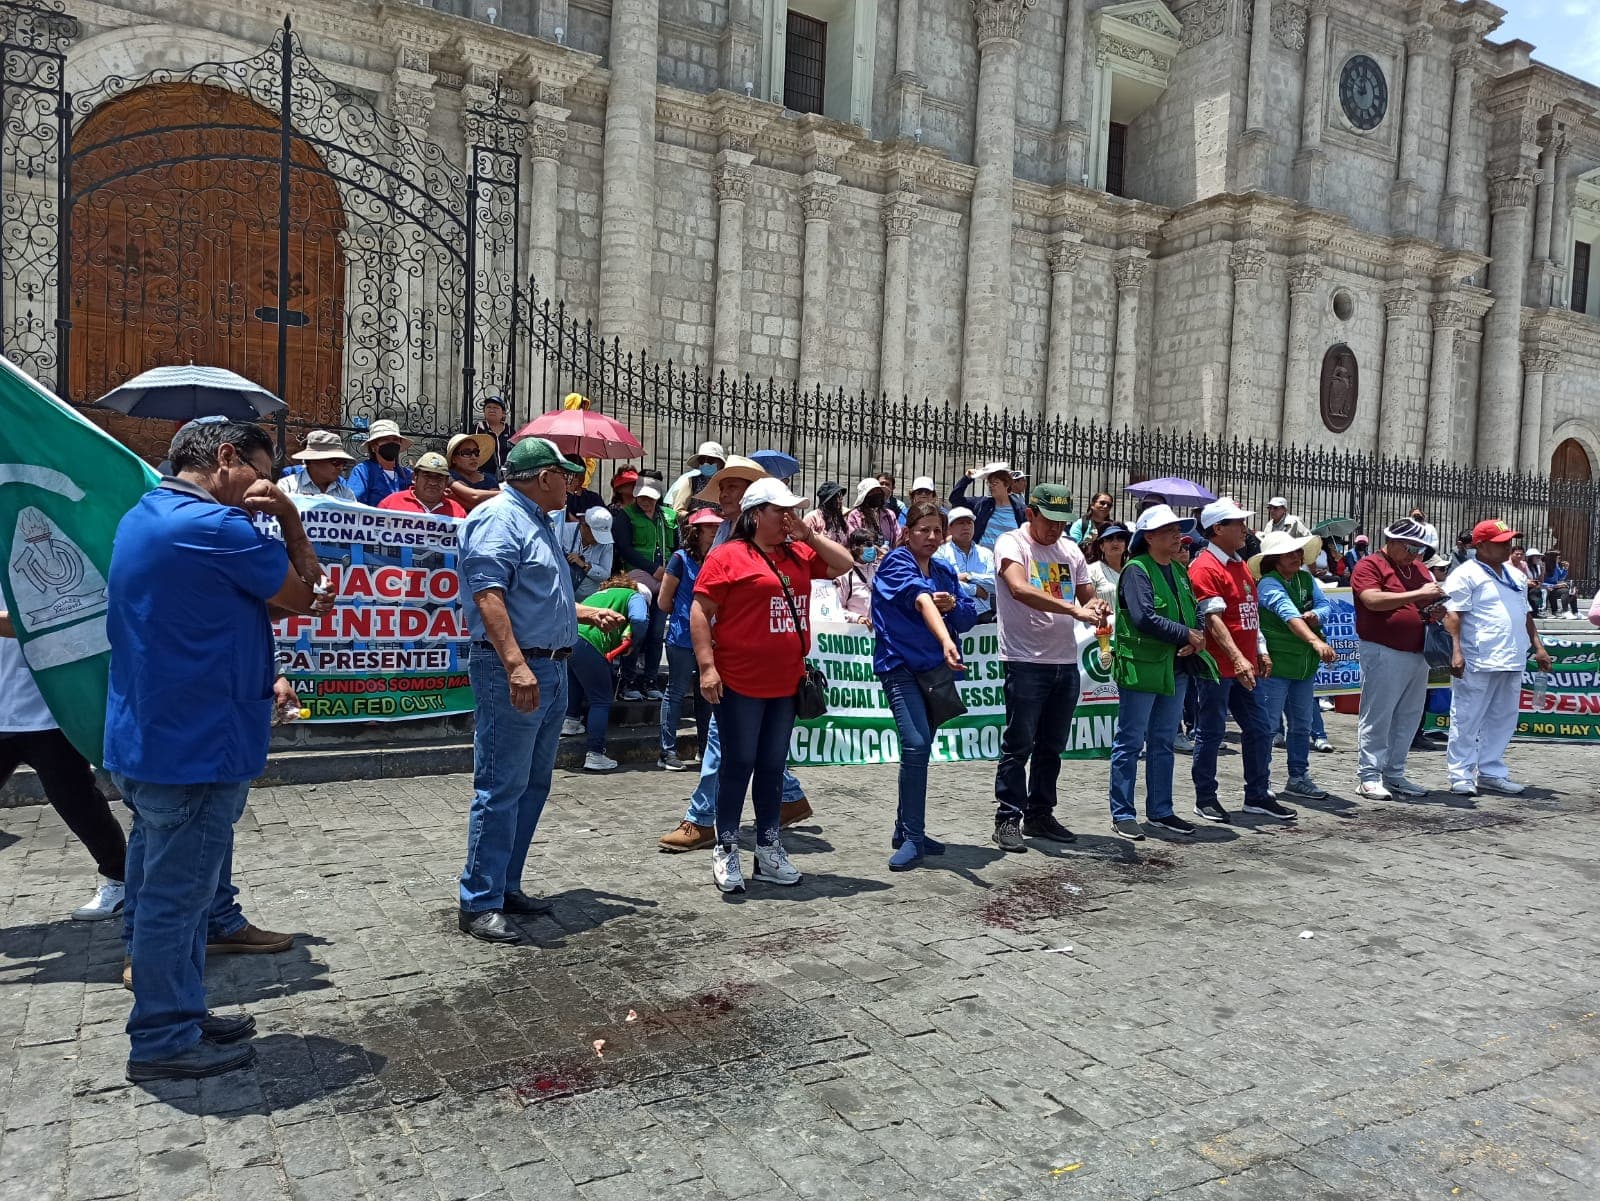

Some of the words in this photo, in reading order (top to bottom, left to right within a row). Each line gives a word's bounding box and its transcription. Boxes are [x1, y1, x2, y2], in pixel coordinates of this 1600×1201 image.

[362, 515, 386, 528] DE
[381, 531, 425, 545] CASE
[319, 651, 447, 670] PRESENTE!
[387, 678, 445, 694] SOMOS
[353, 698, 396, 715] FED
[401, 695, 446, 713] CUT!
[1533, 723, 1555, 734] NO
[1560, 725, 1590, 736] HAY
[788, 722, 900, 763] CLÍNICO
